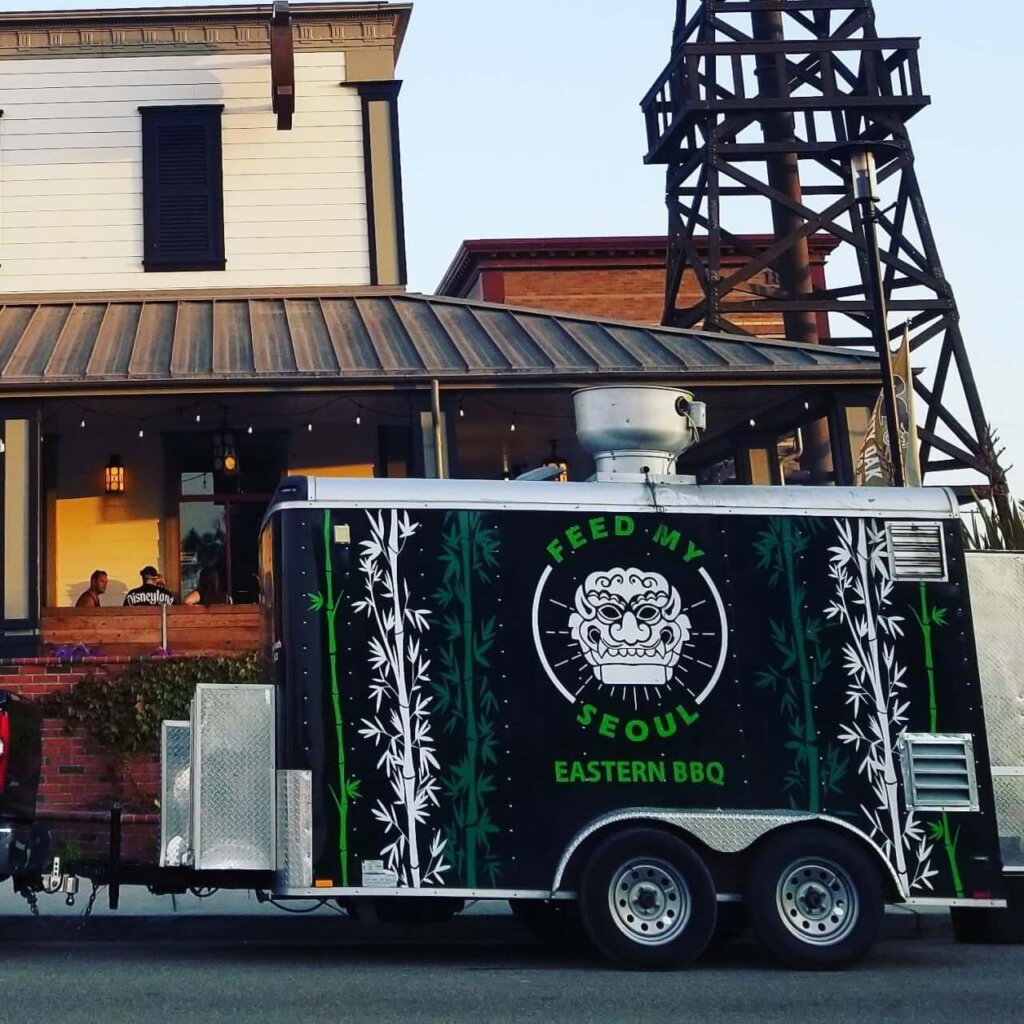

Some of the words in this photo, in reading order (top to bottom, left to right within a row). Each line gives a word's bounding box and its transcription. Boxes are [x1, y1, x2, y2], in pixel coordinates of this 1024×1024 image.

[864, 444, 883, 482] OAK
[546, 515, 635, 563] FEED
[652, 524, 705, 563] MY
[127, 589, 174, 607] Disneyland
[576, 703, 700, 742] SEOUL
[555, 760, 665, 783] EASTERN
[672, 760, 725, 786] BBQ
